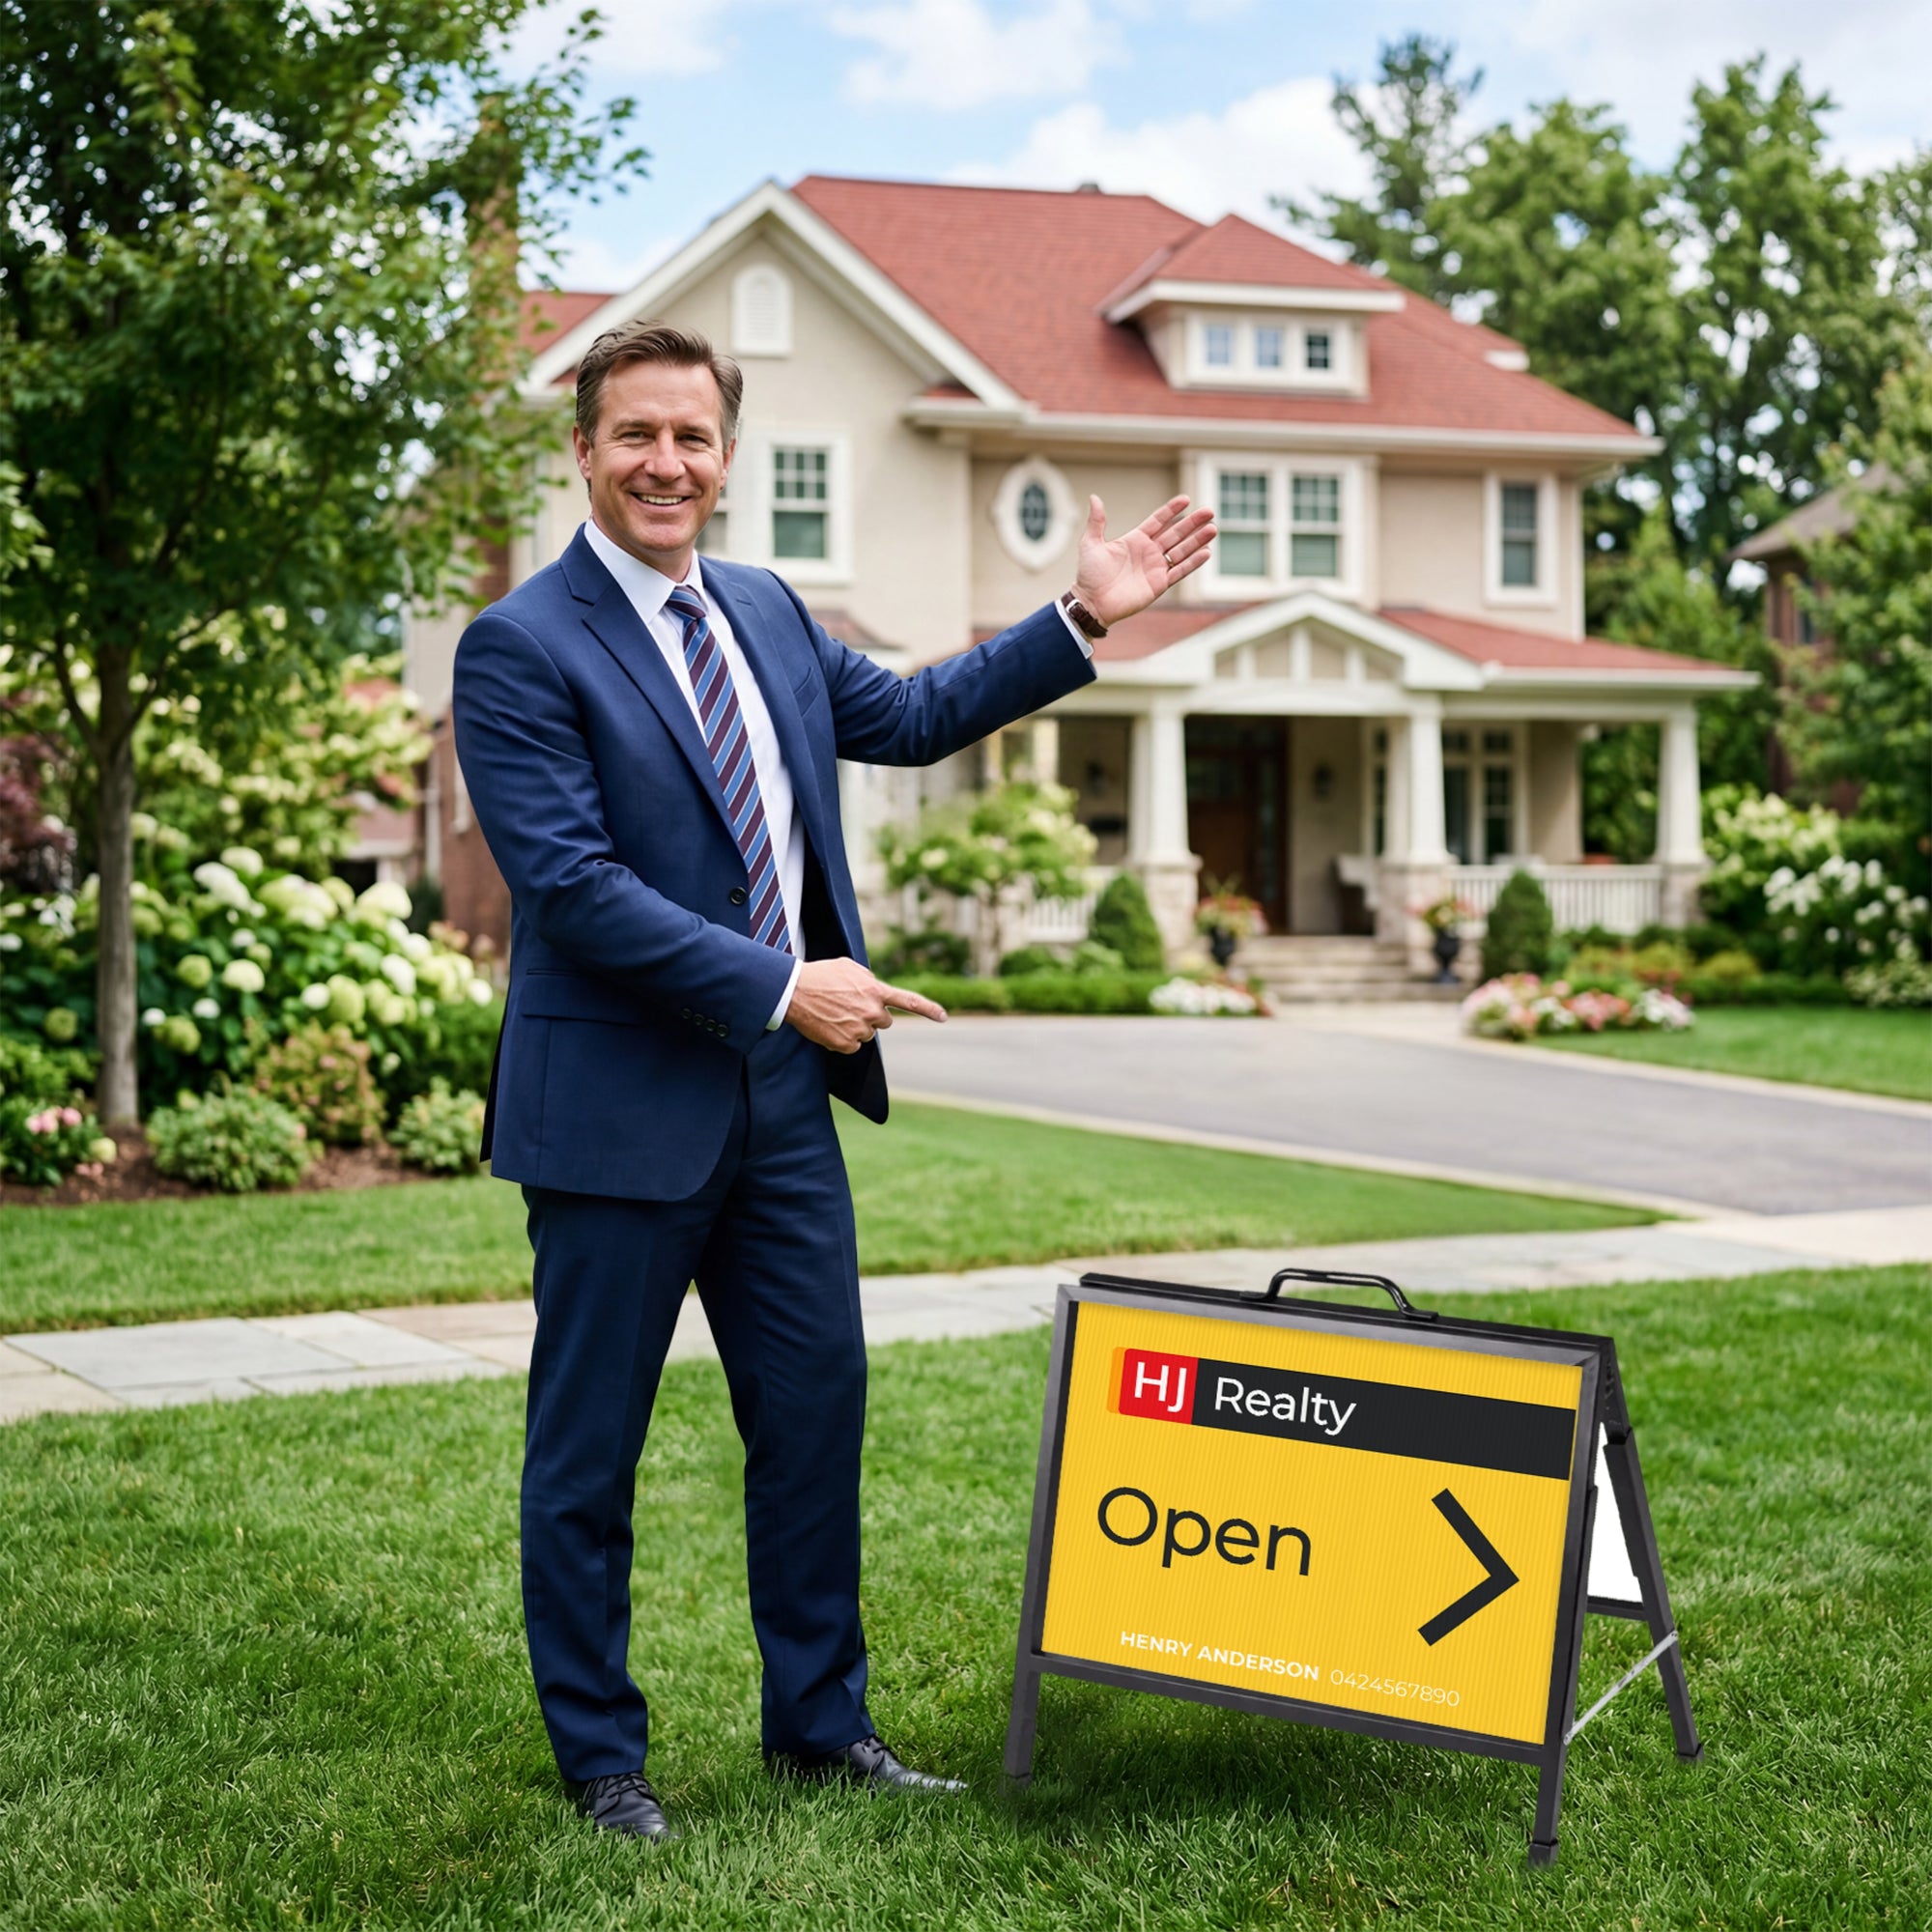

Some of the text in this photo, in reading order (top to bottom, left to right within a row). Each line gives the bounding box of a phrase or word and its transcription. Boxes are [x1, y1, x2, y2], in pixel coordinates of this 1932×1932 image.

[1134, 1361, 1357, 1436] HJ Realty
[1097, 1486, 1312, 1577] Open
[1120, 1631, 1461, 1707] HENRY ANDERSON 0424567890
